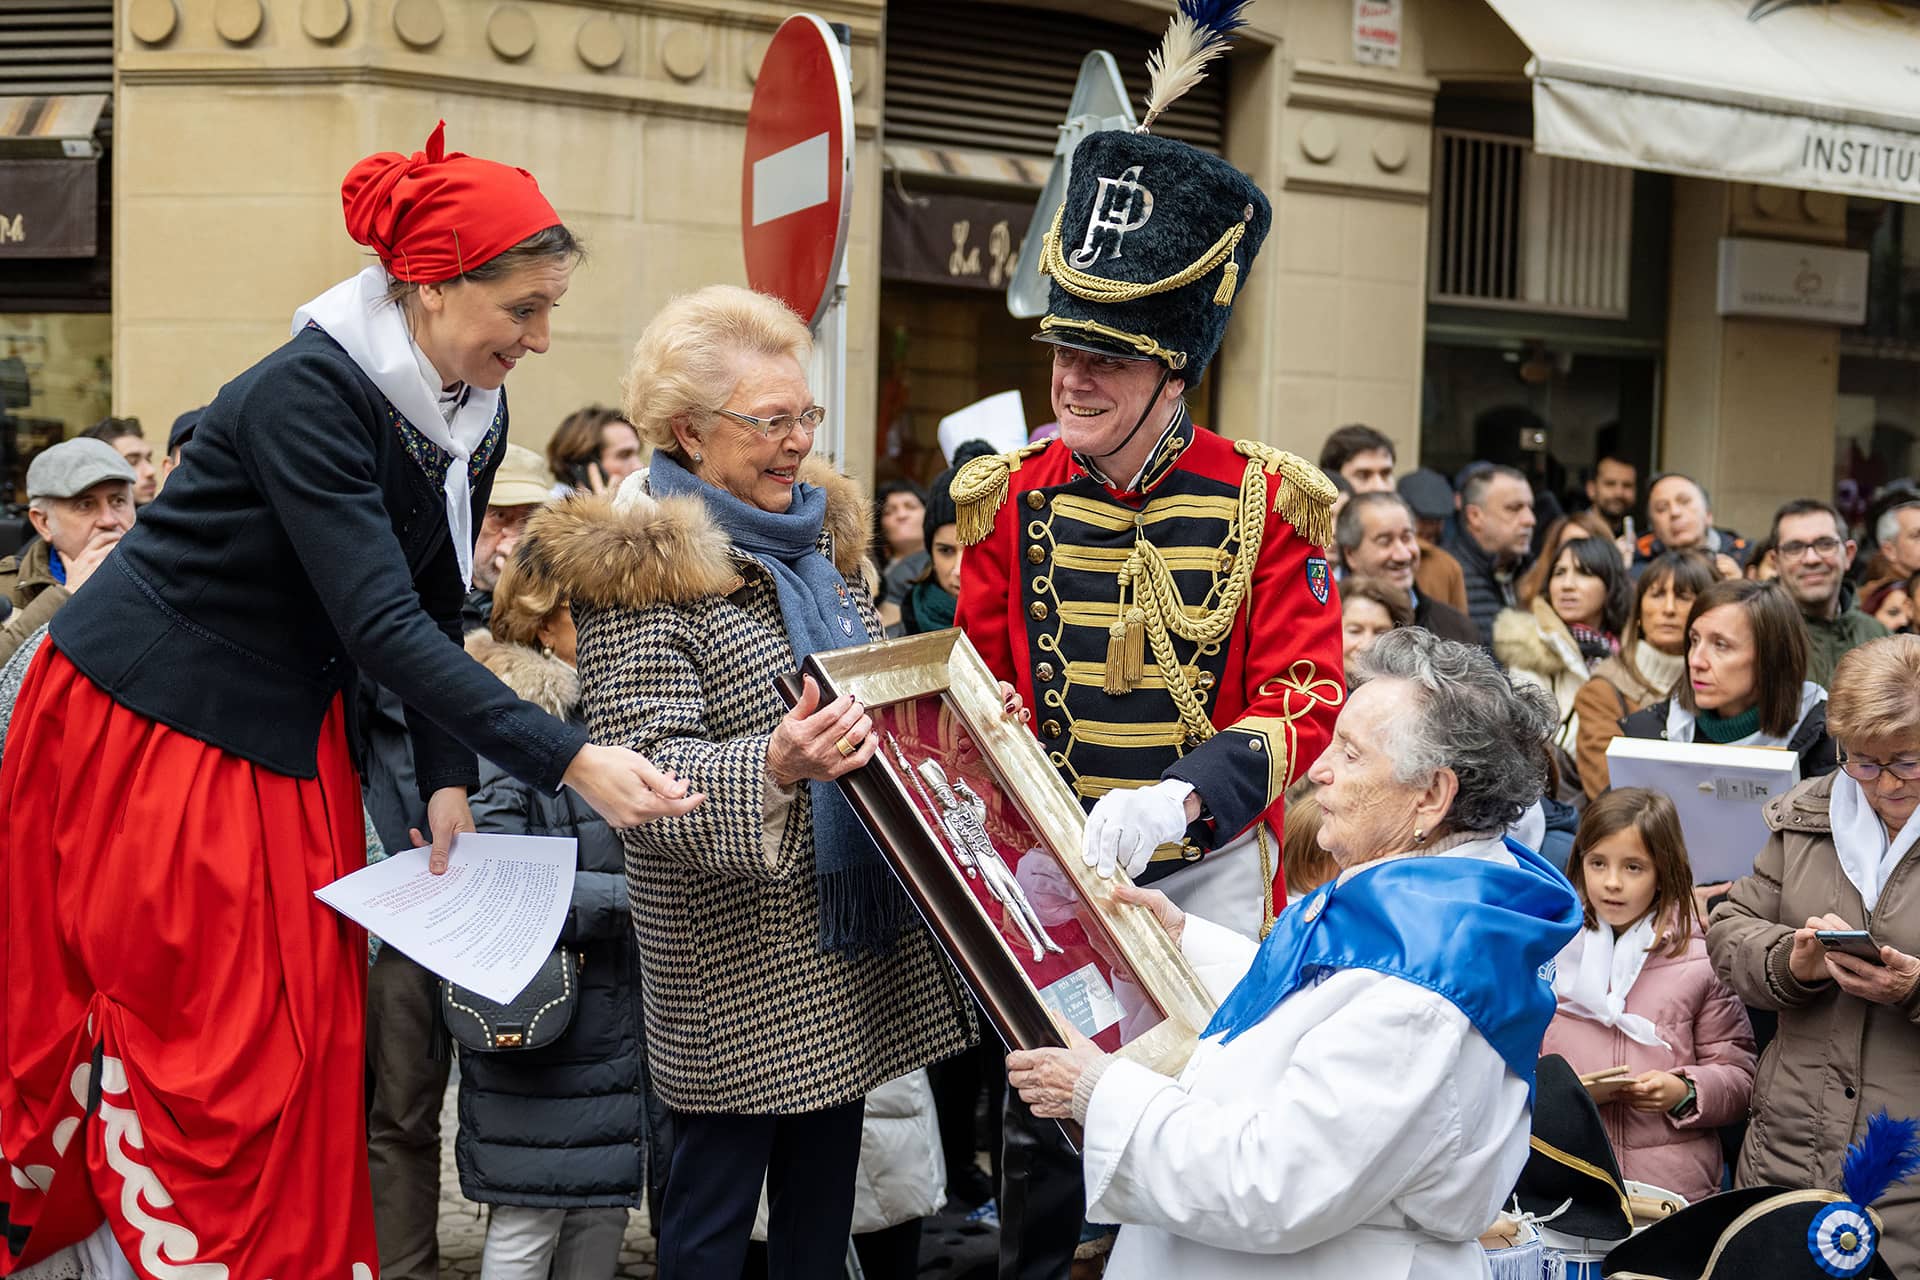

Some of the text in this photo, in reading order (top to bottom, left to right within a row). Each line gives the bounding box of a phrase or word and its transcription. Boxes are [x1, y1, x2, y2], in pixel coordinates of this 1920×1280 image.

[1802, 135, 1920, 183] INSTITU
[949, 221, 1024, 286] La Pa
